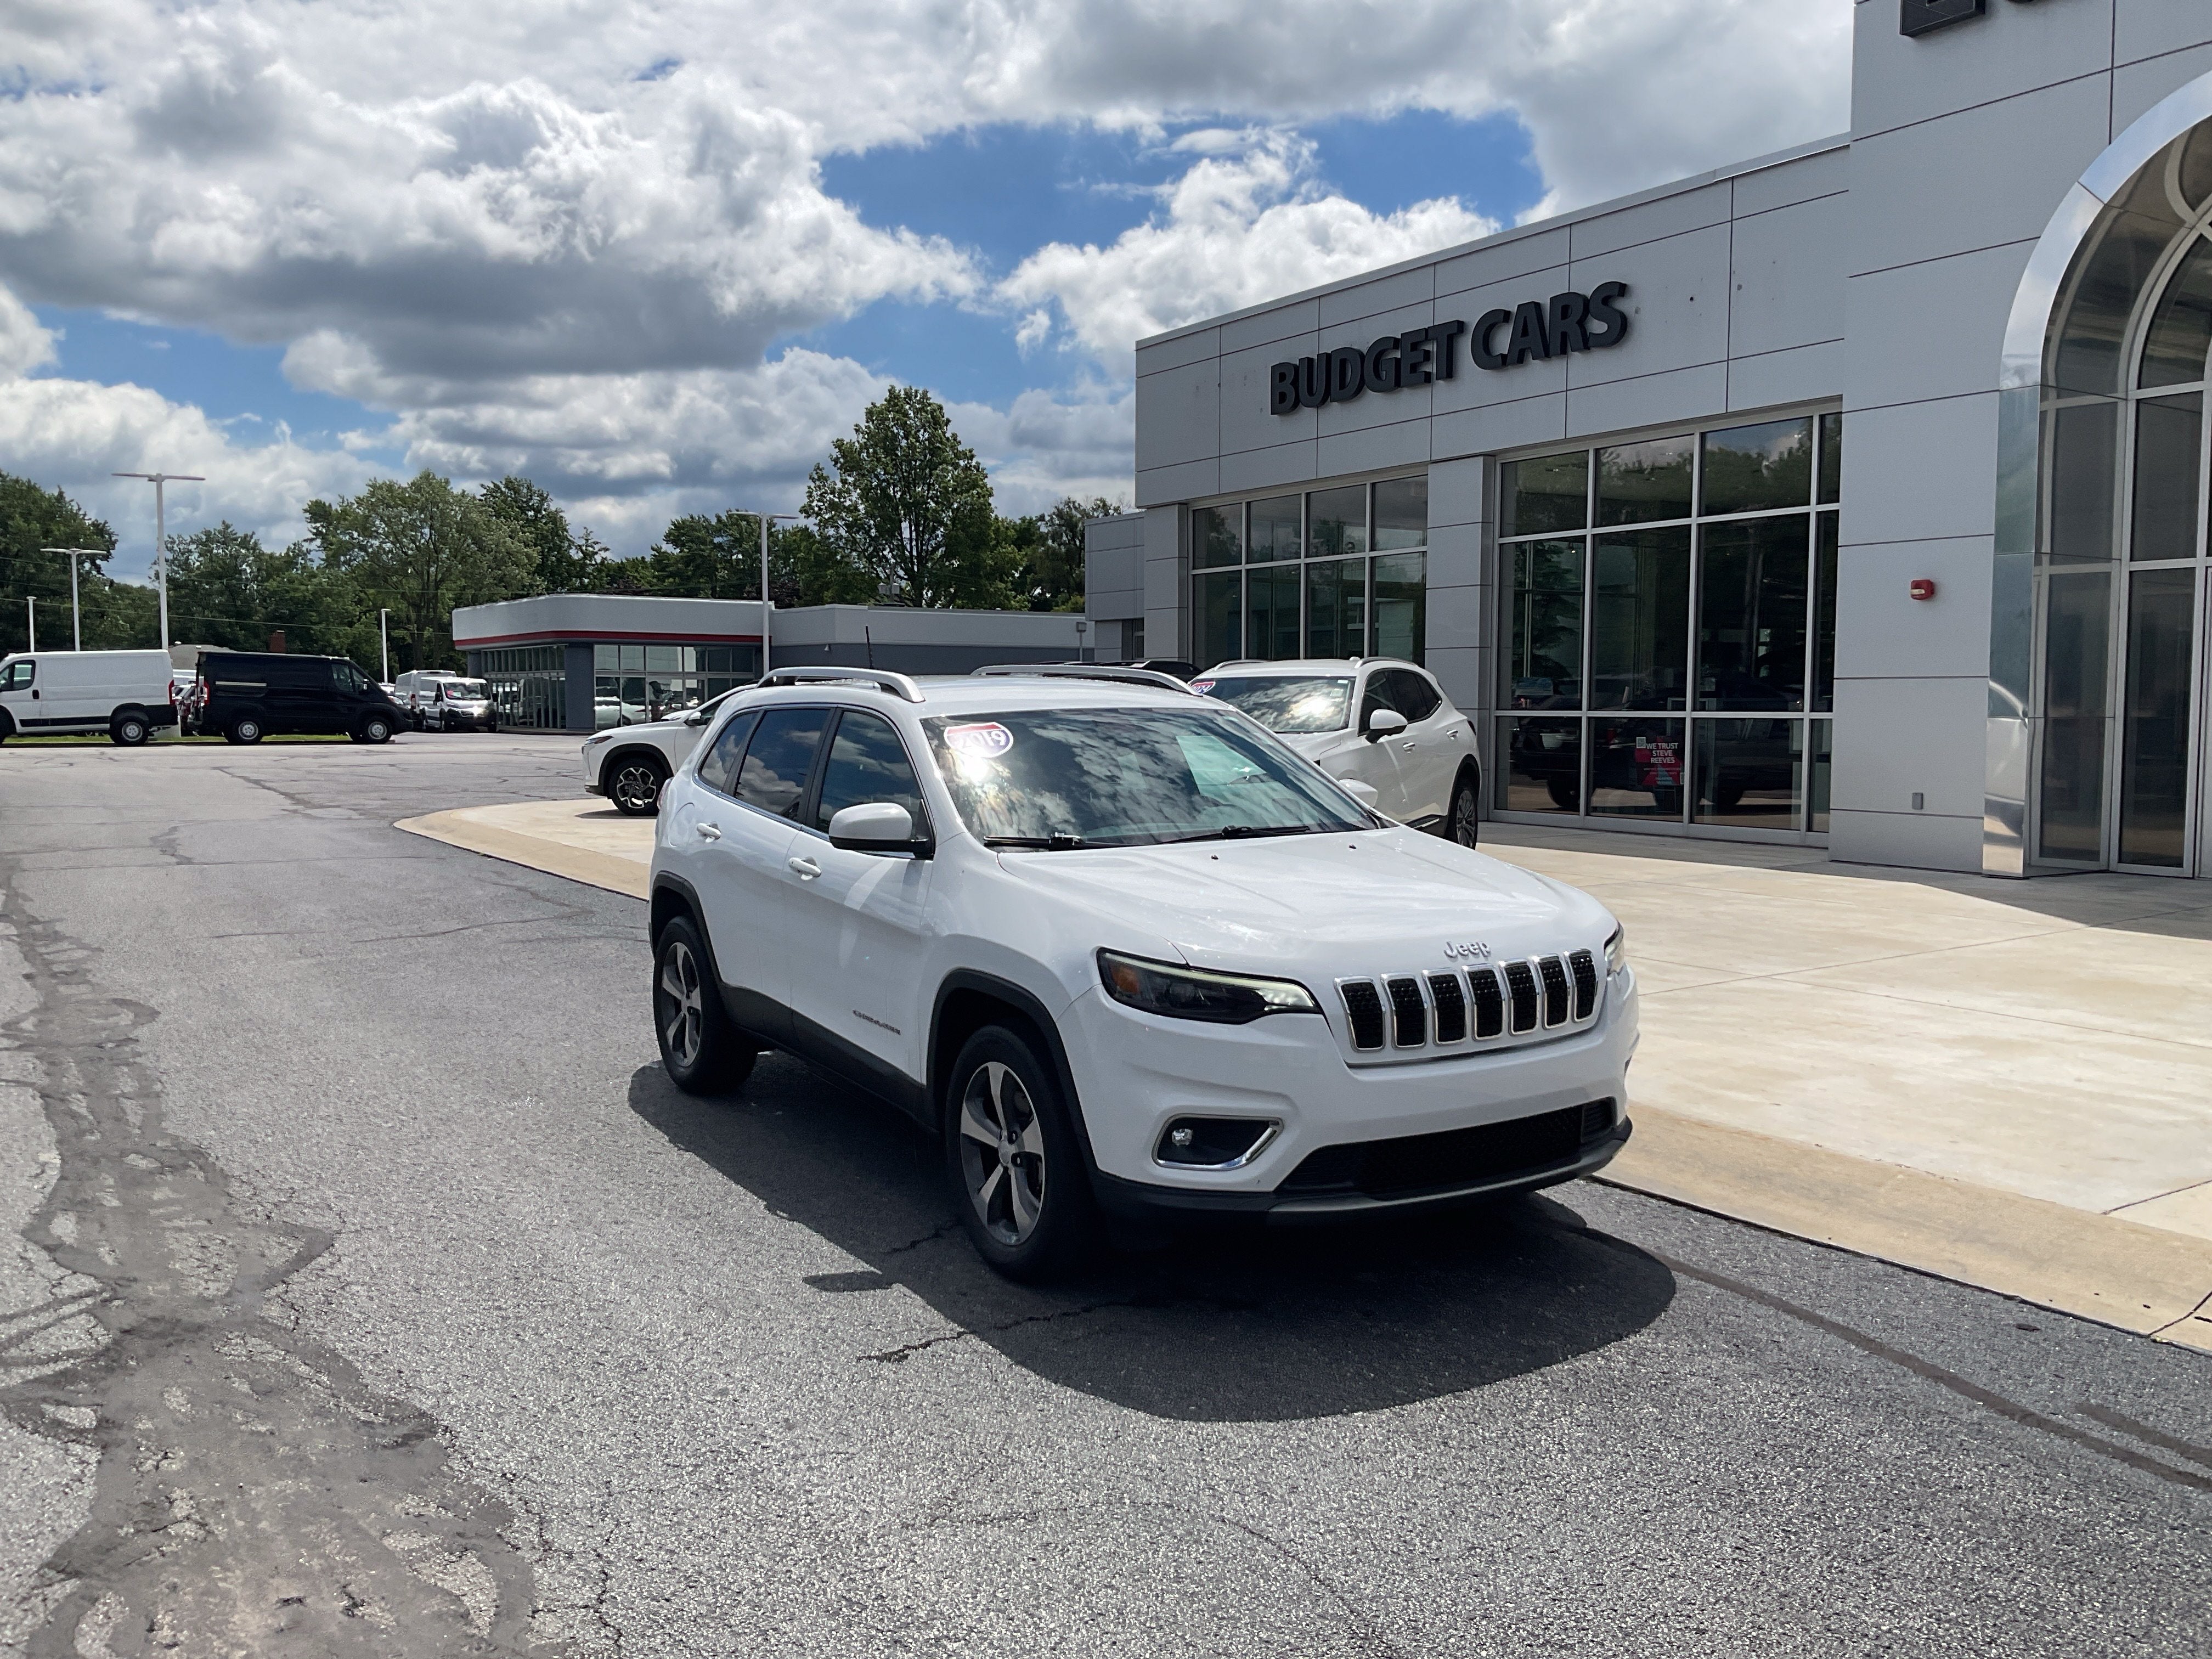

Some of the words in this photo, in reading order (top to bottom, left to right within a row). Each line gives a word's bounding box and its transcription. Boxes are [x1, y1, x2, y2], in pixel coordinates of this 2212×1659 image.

[1271, 320, 1466, 415] BUDGET
[1471, 281, 1628, 371] CARS
[953, 731, 1005, 748] 2019
[1443, 941, 1491, 959] Jeep
